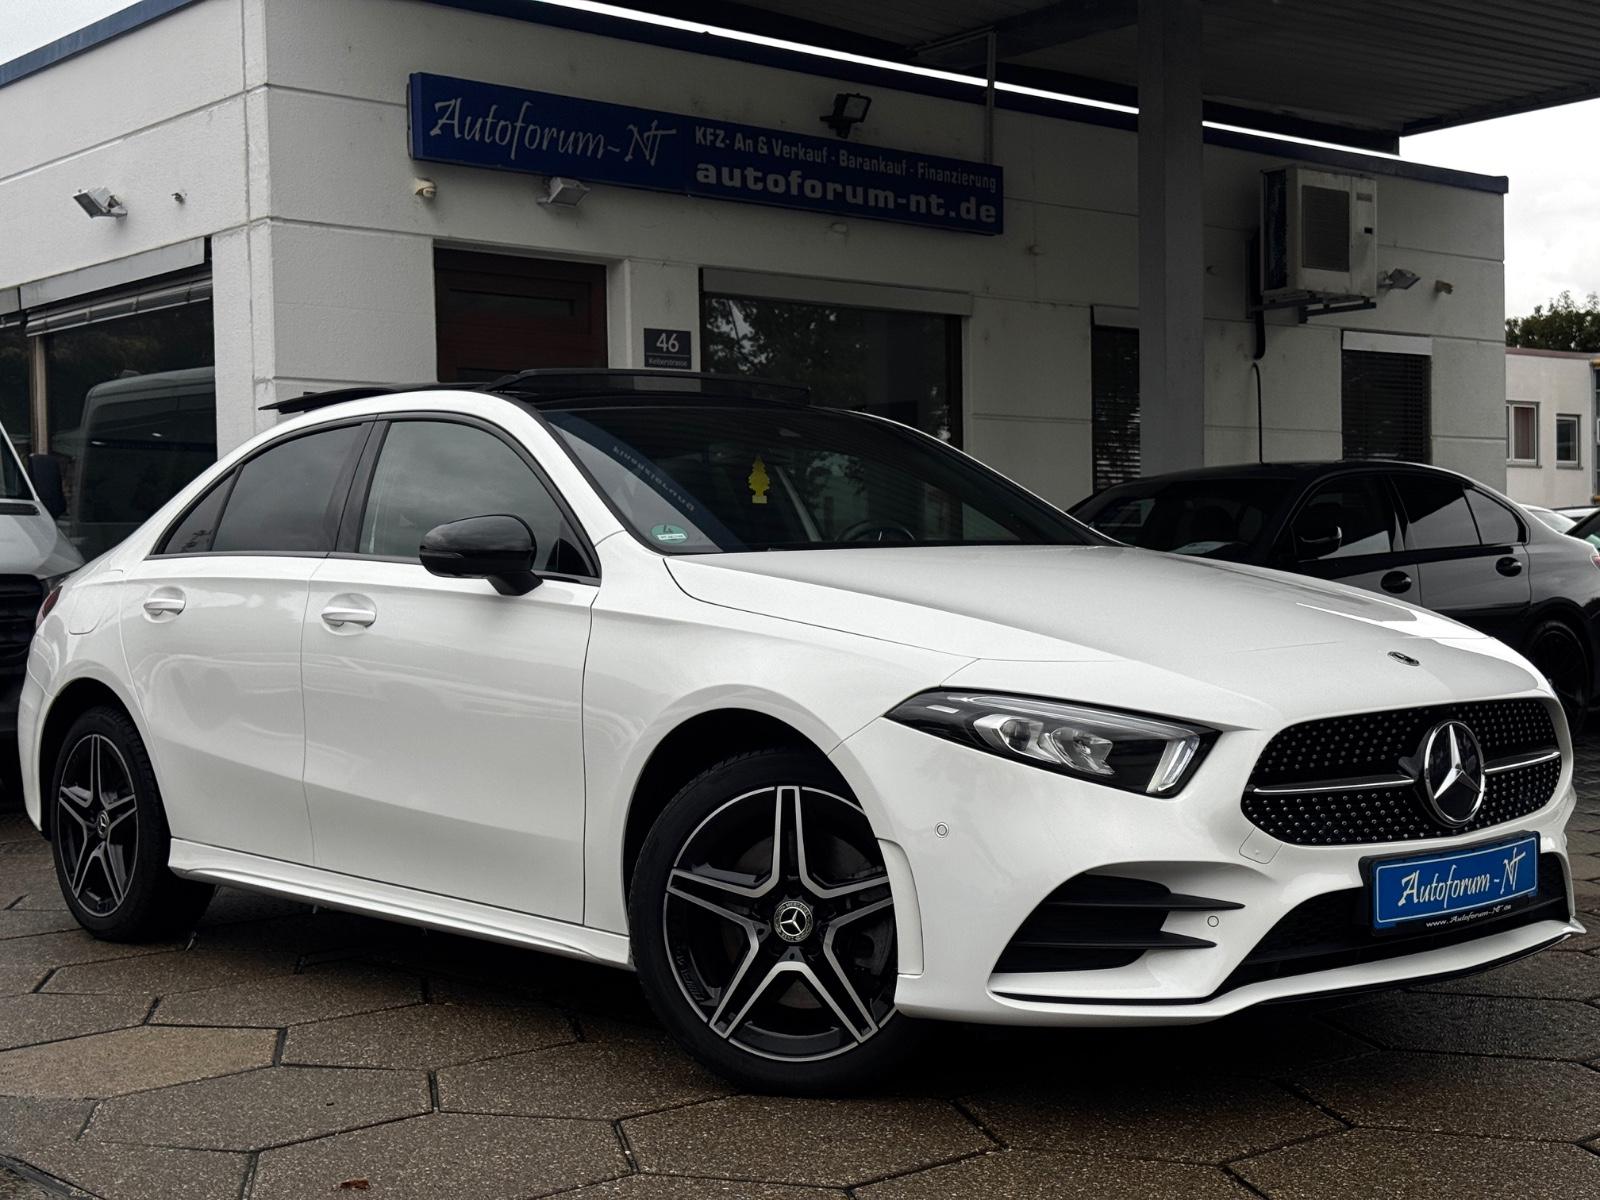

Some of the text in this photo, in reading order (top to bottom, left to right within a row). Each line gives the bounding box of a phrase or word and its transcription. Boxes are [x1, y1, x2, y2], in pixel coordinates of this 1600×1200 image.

[430, 97, 677, 166] Autoforum-NT
[696, 161, 996, 223] autoforum-nt.de
[734, 133, 754, 153] An
[758, 136, 768, 155] &
[772, 139, 829, 164] Verkauf
[839, 149, 907, 177] Barankauf
[917, 162, 997, 193] Finanzierung
[656, 333, 679, 352] 46
